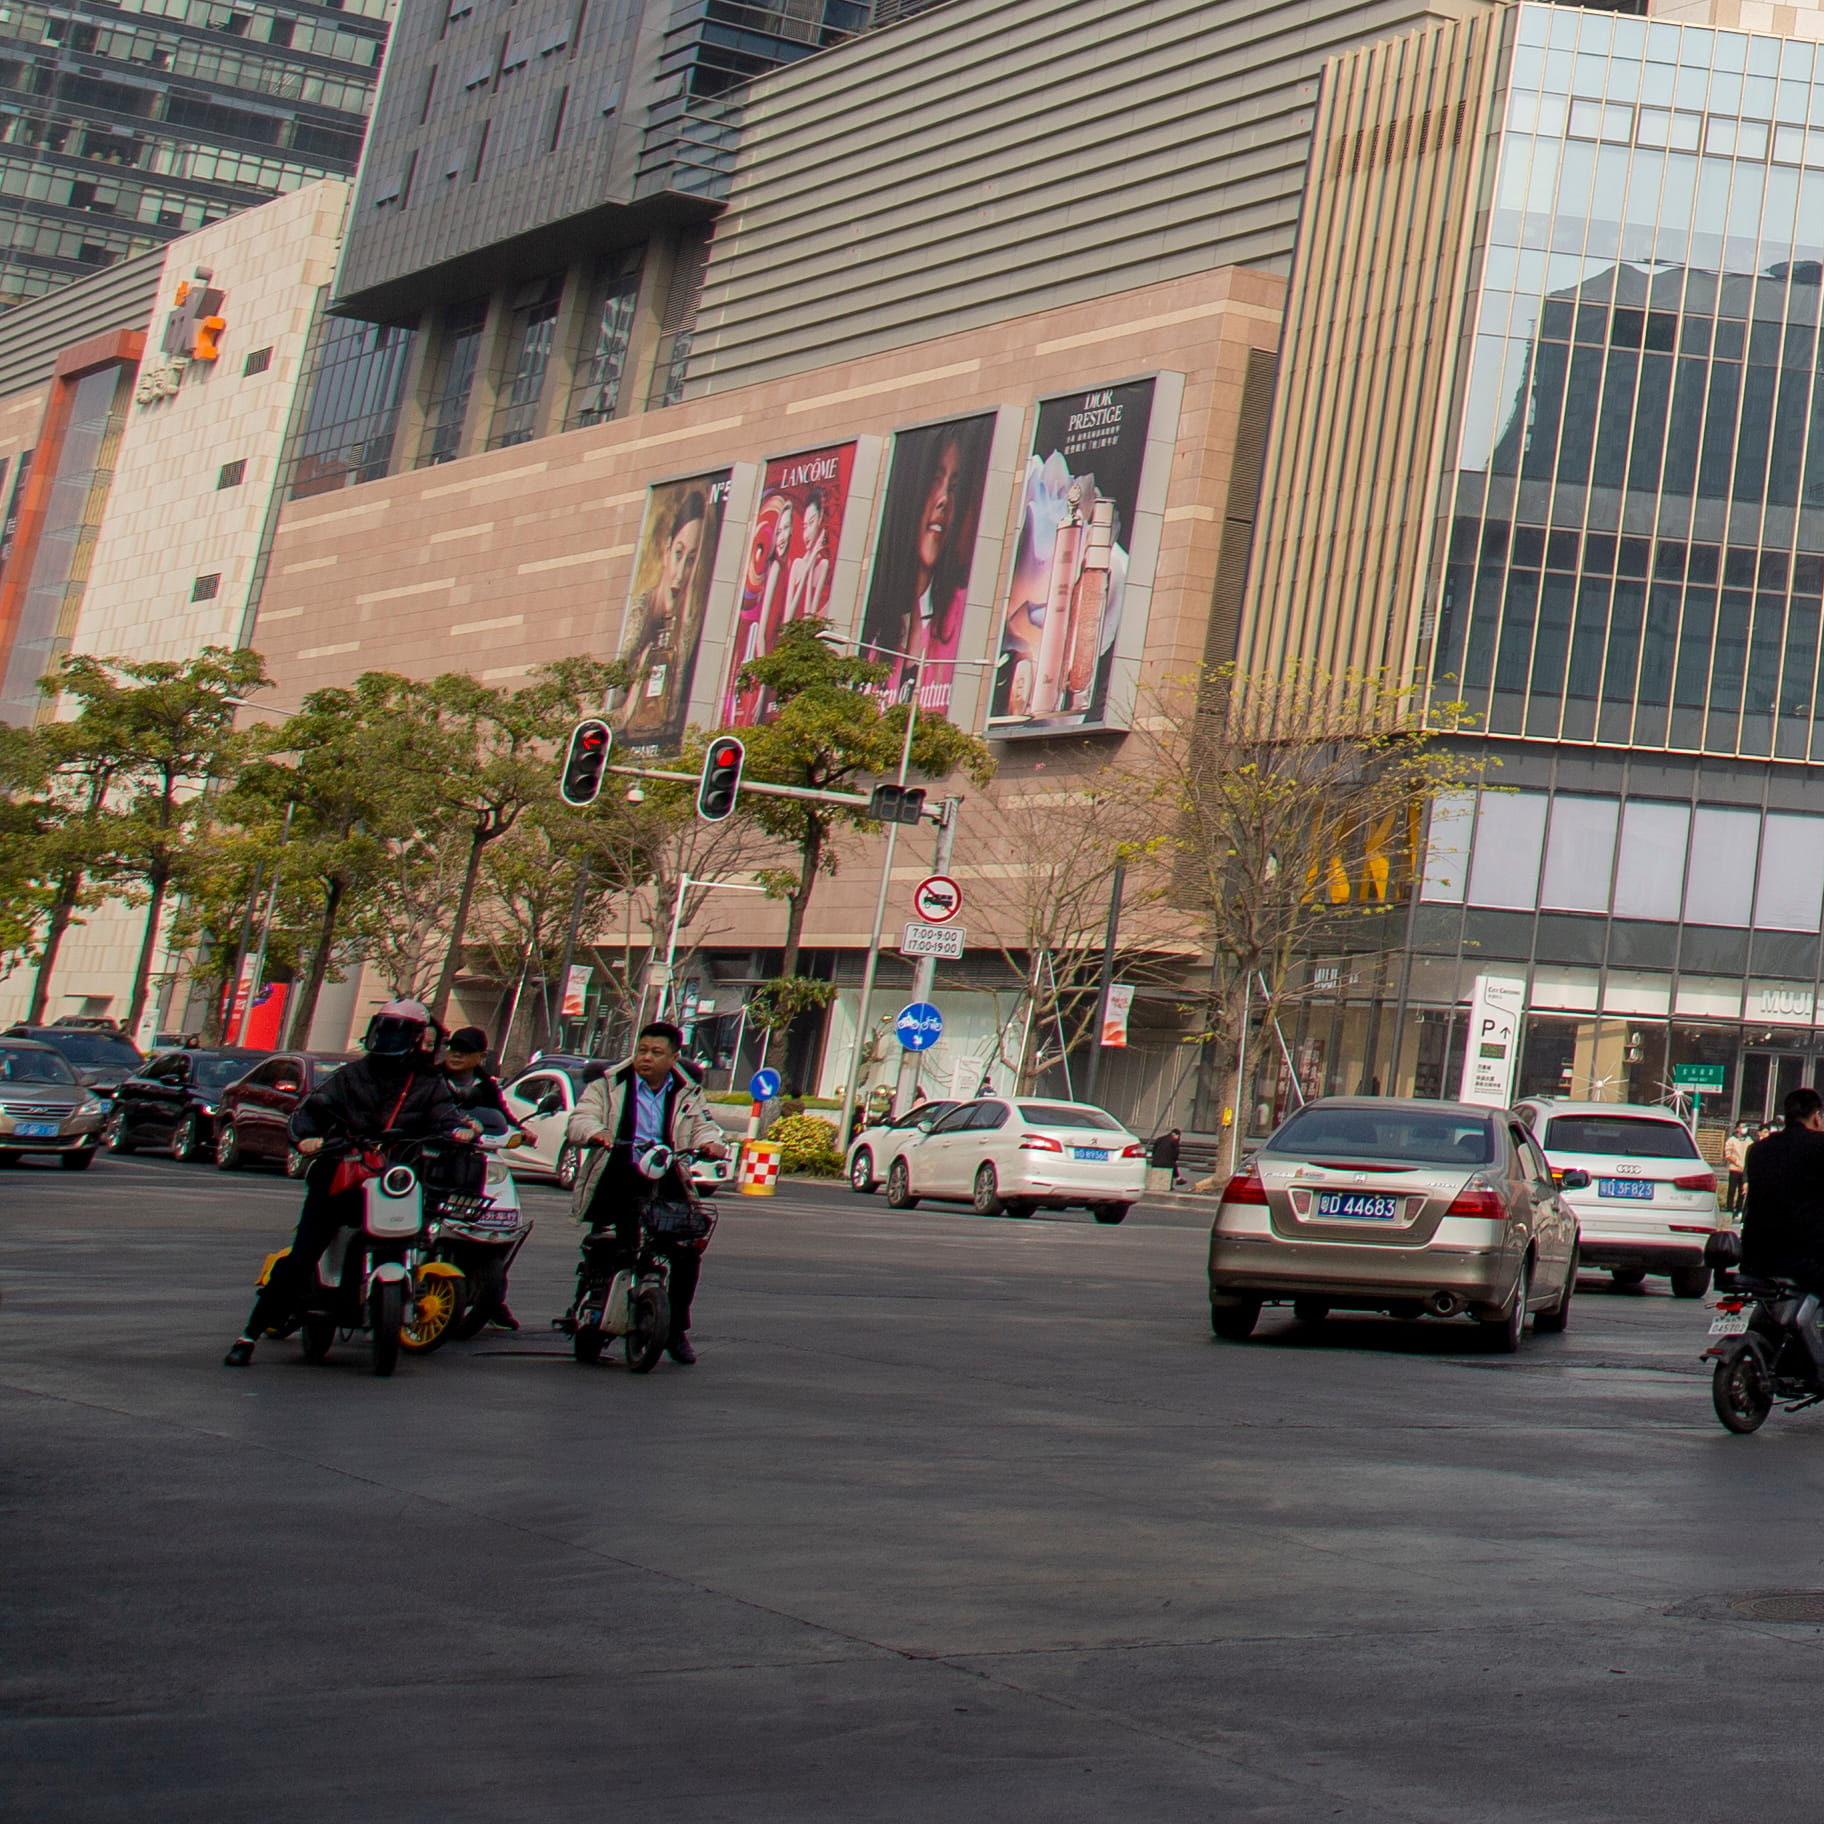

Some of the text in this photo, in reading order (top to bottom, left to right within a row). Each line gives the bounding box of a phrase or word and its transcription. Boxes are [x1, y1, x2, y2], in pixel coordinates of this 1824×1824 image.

[1084, 389, 1113, 410] DIOR
[1068, 405, 1123, 431] PRESTIGE
[780, 457, 838, 489] LANCÔME
[1761, 990, 1813, 1015] MUJI
[1481, 1019, 1496, 1037] P
